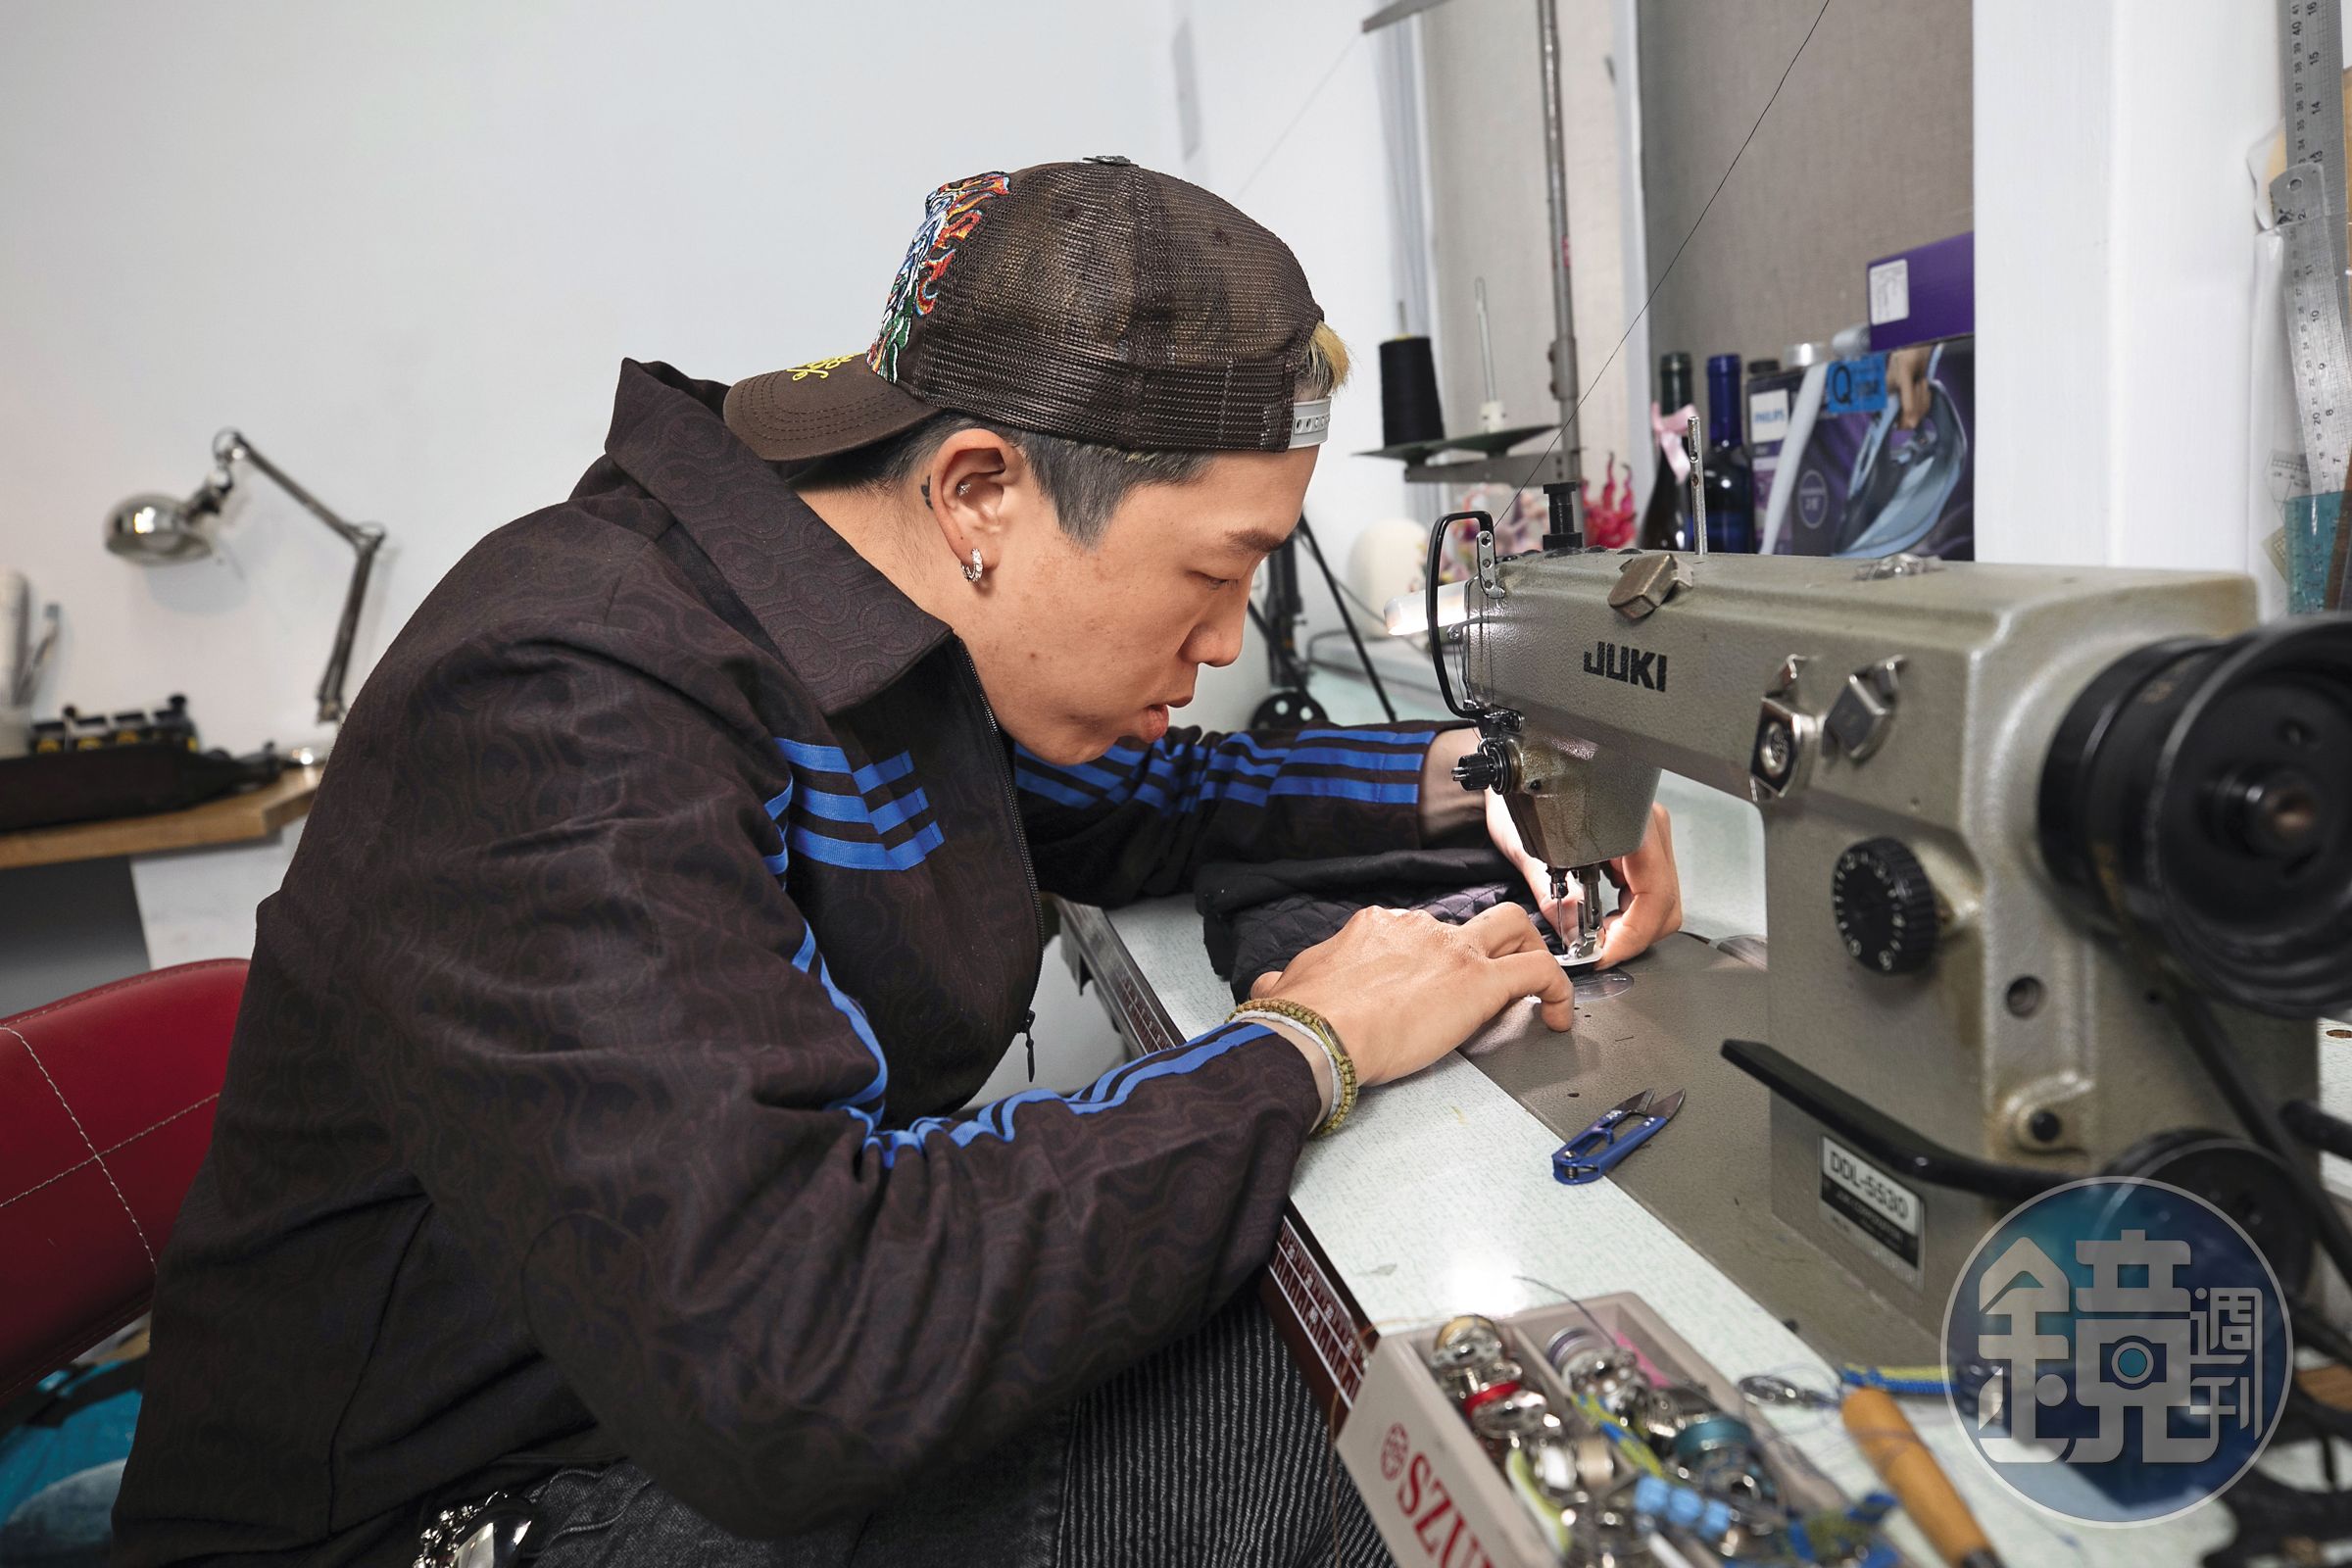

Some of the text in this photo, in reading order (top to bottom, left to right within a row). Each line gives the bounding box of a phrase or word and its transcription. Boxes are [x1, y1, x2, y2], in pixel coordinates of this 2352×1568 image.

[2307, 1, 2318, 16] 16
[2291, 21, 2302, 35] 40
[2309, 51, 2320, 66] 15
[2311, 101, 2322, 115] 14
[2304, 264, 2314, 275] 11
[2311, 310, 2321, 322] 10
[1833, 365, 1853, 406] Q
[2312, 412, 2322, 426] 20
[2325, 408, 2334, 416] 8
[1583, 640, 1668, 693] JUKI
[1829, 1150, 1909, 1221] DDL-5530
